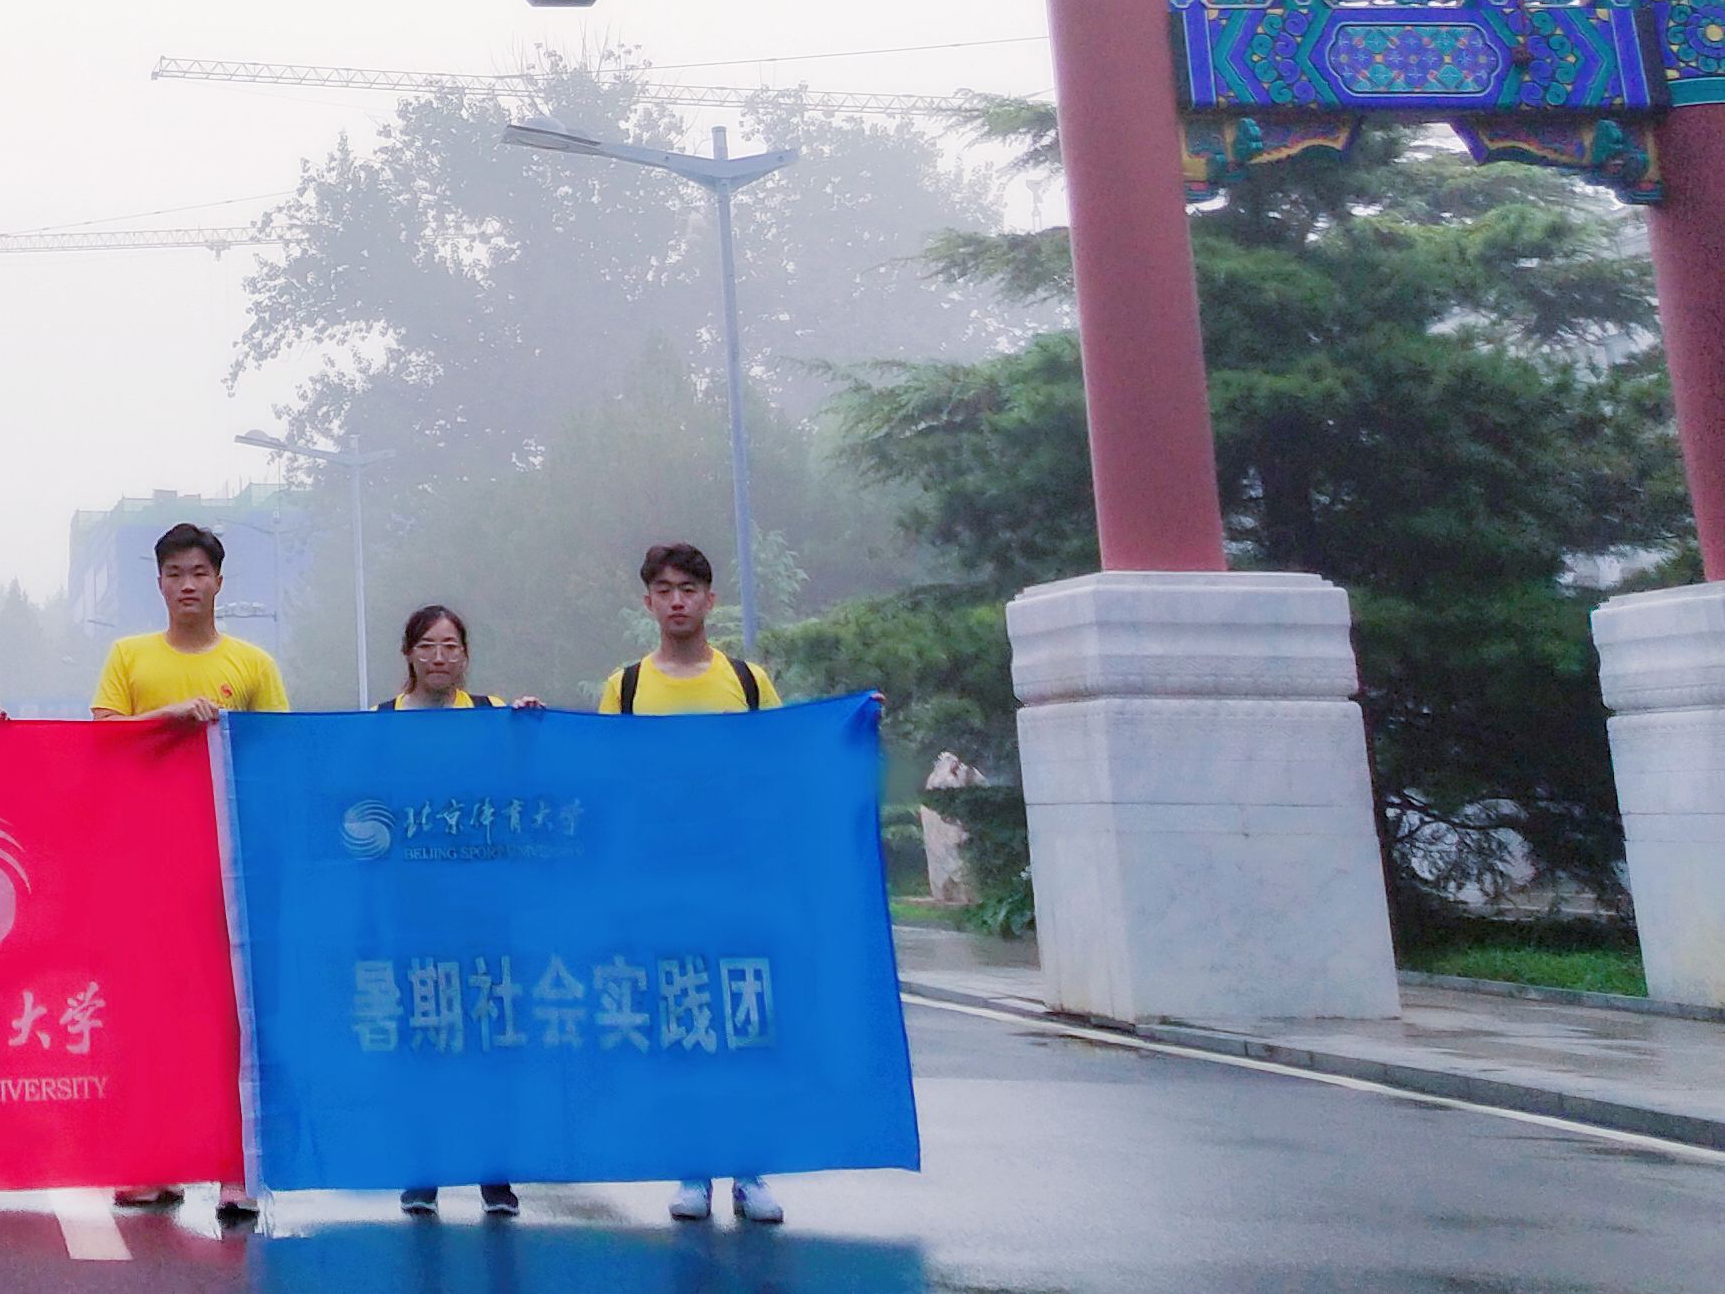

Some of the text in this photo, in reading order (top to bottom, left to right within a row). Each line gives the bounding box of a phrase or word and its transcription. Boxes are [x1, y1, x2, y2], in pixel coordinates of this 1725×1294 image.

[404, 847, 457, 860] BEIJING
[354, 954, 775, 1053] 暑期社会实践团
